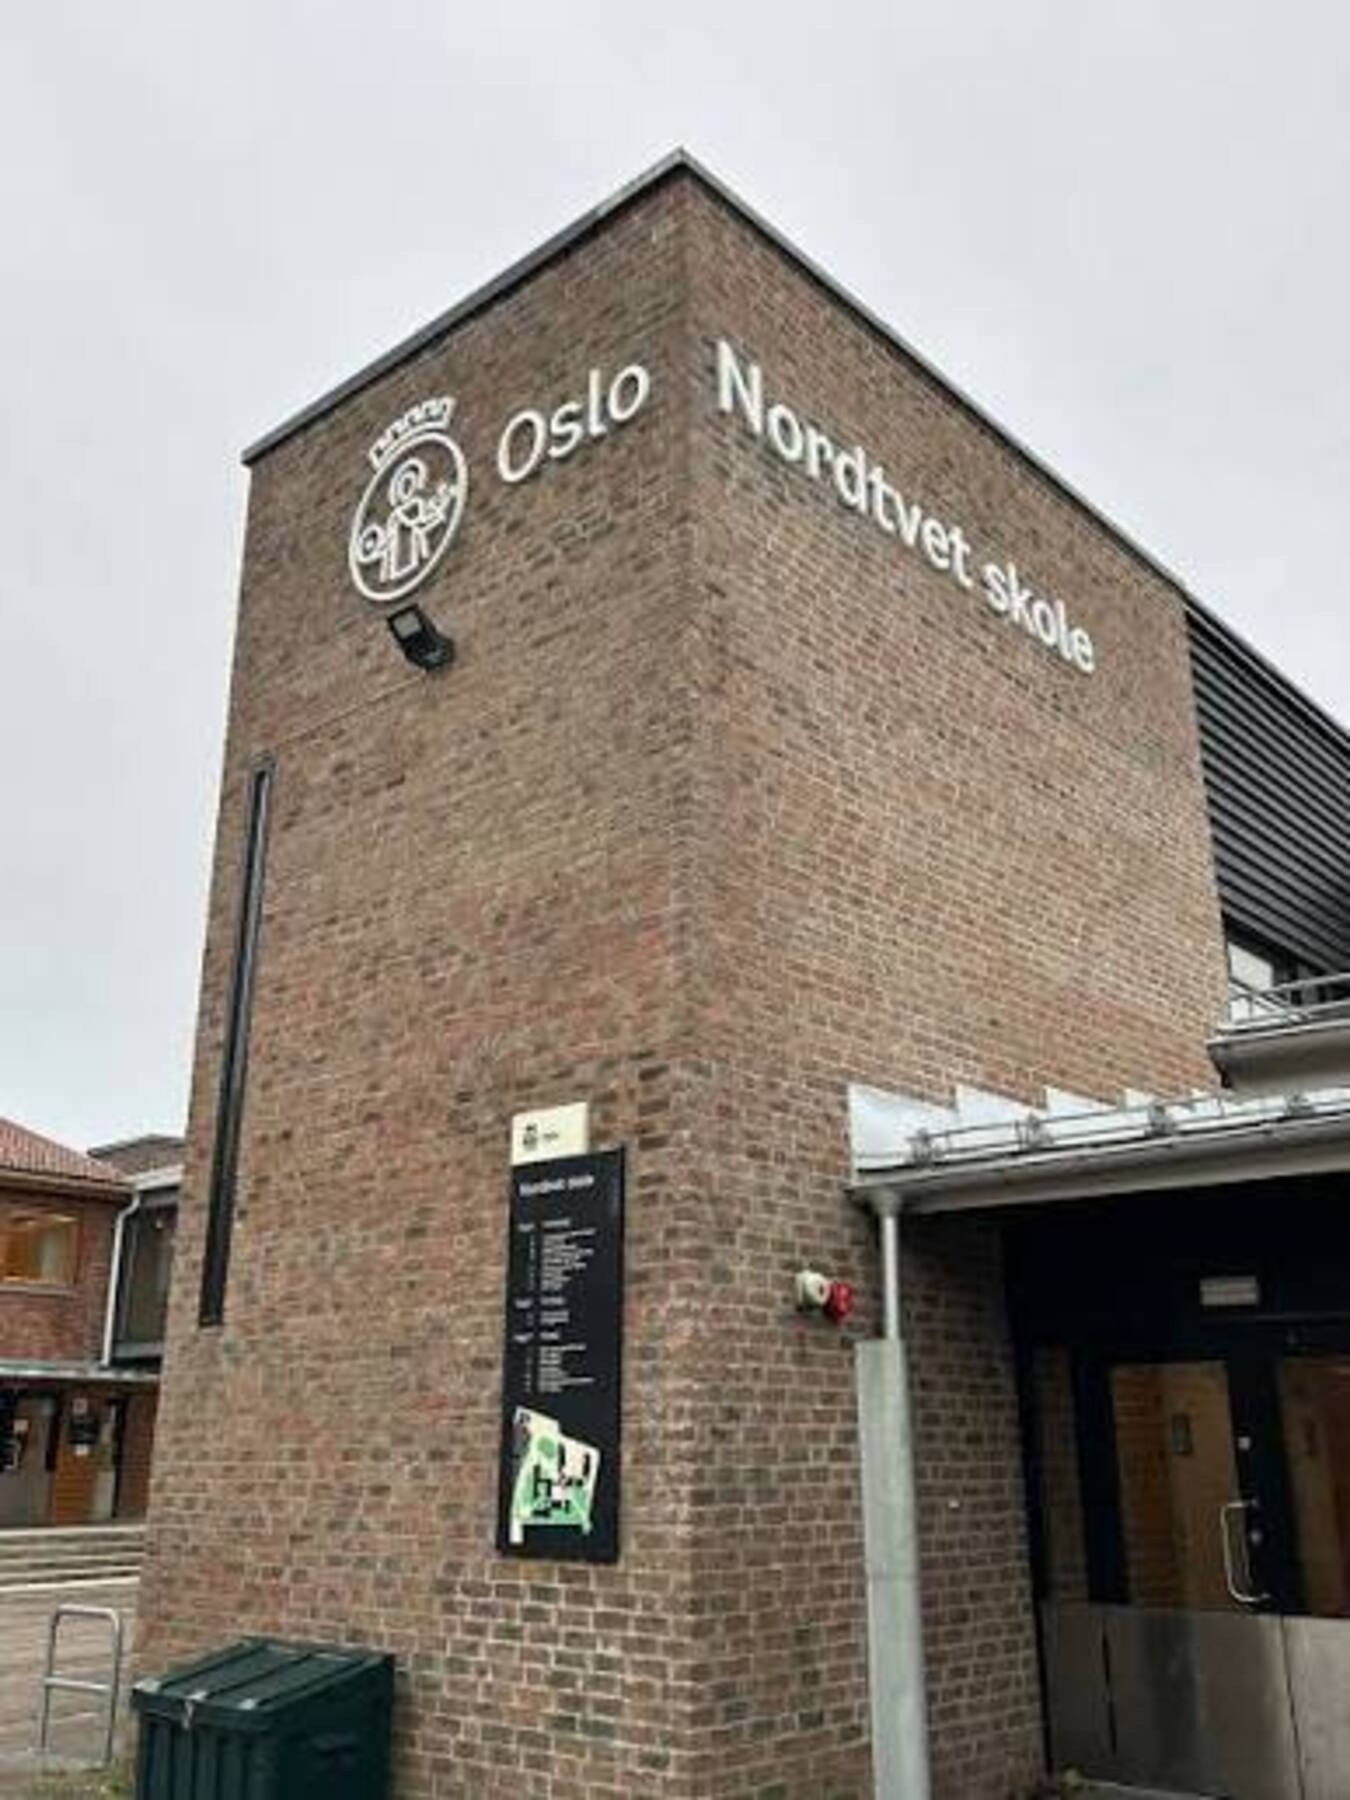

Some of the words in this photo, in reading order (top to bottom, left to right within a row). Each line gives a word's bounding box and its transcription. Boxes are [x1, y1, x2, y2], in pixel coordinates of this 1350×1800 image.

[497, 364, 650, 483] Oslo
[716, 340, 973, 587] Nordtvet
[983, 563, 1096, 673] skole
